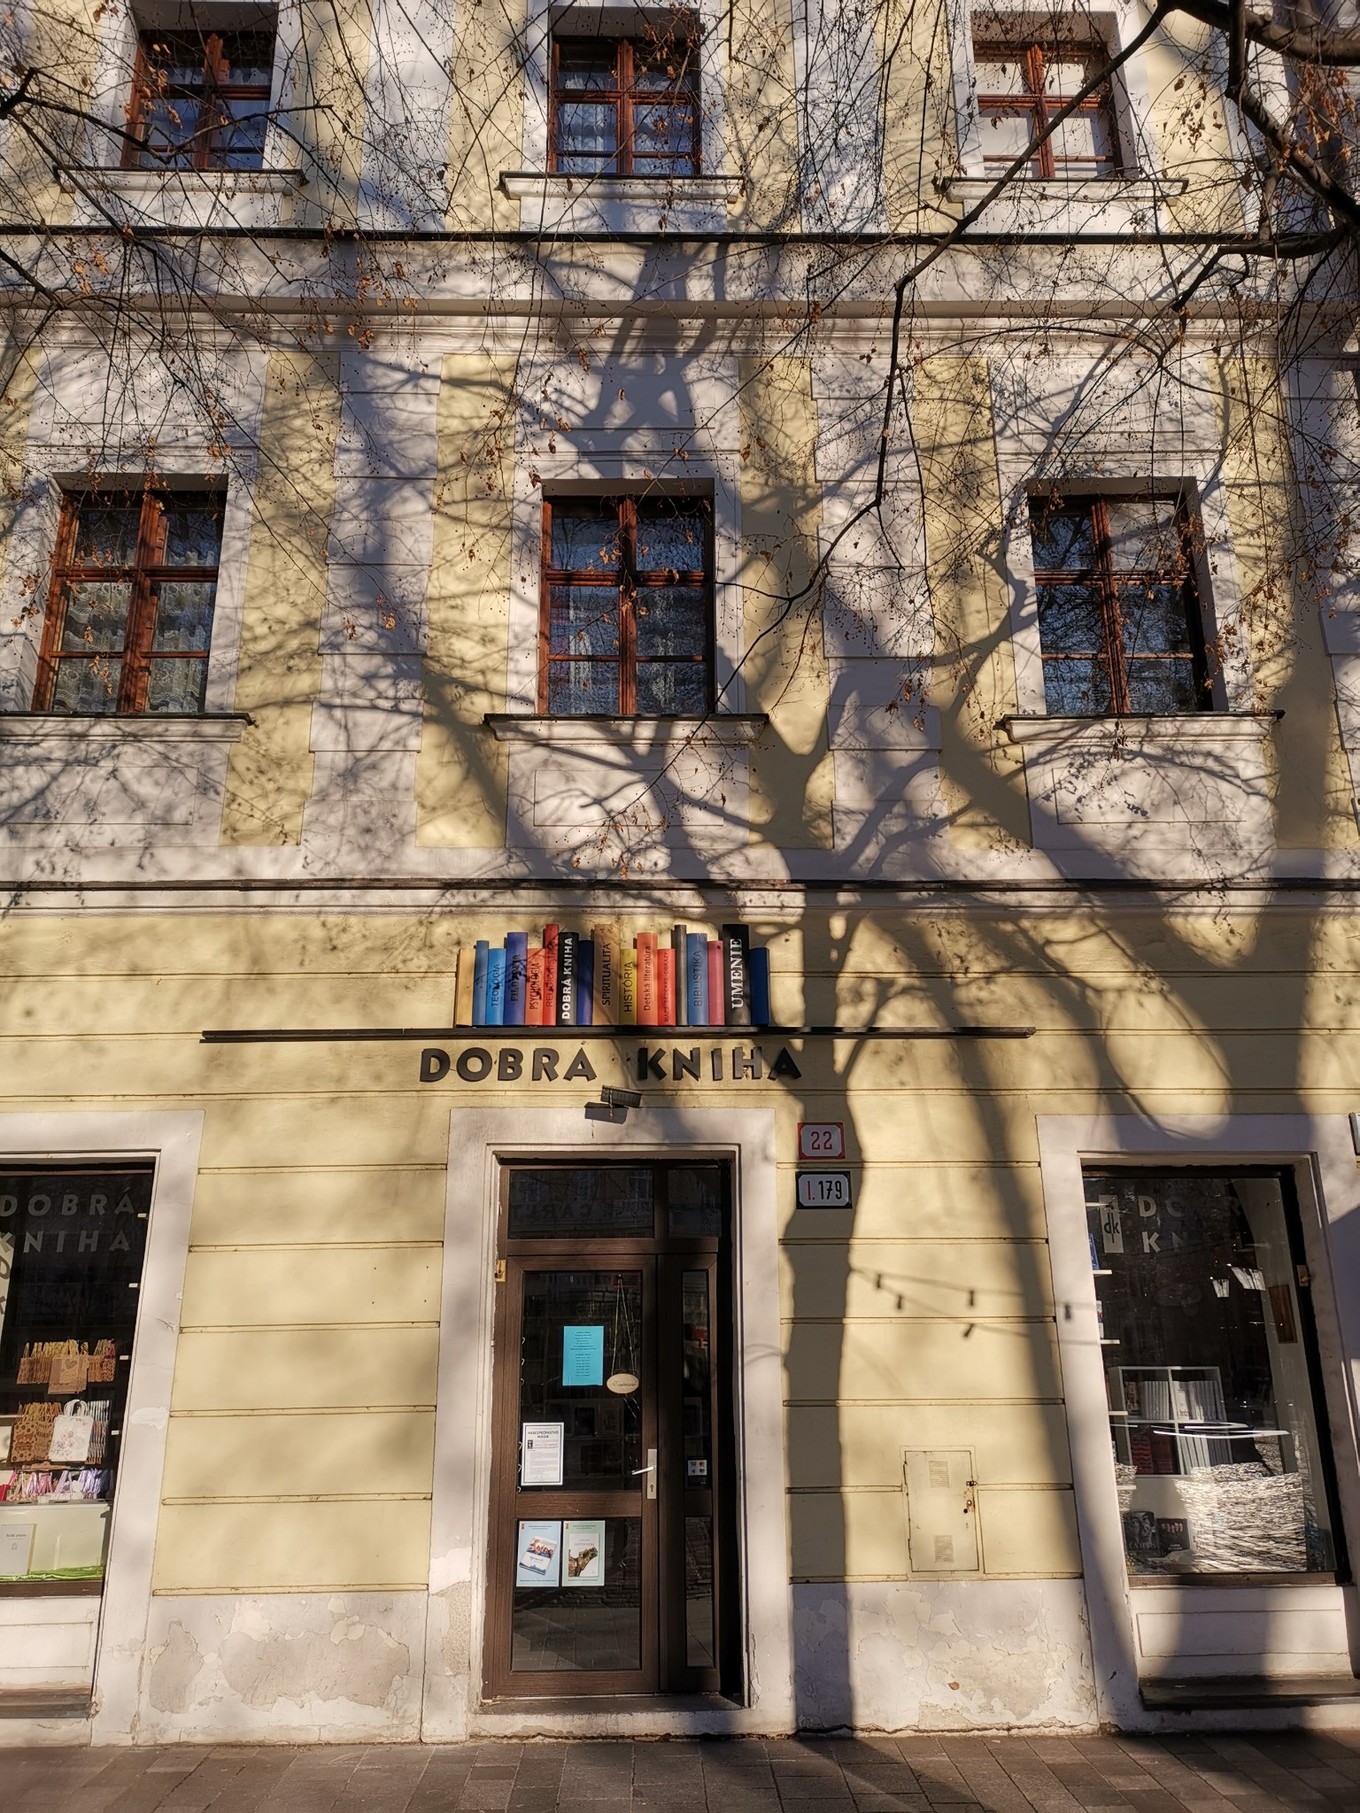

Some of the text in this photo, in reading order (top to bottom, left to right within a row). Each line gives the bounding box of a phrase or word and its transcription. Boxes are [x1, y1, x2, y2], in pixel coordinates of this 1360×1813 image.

[561, 938, 573, 1020] DOBRÁ KNIHA
[622, 961, 633, 1013] HISTÓRIA
[643, 945, 652, 1011] Detská literatúra
[693, 950, 703, 1007] BIBLISTIKA
[730, 938, 745, 1009] UMENIE
[637, 1045, 802, 1081] KNIHA
[810, 1131, 833, 1150] 22
